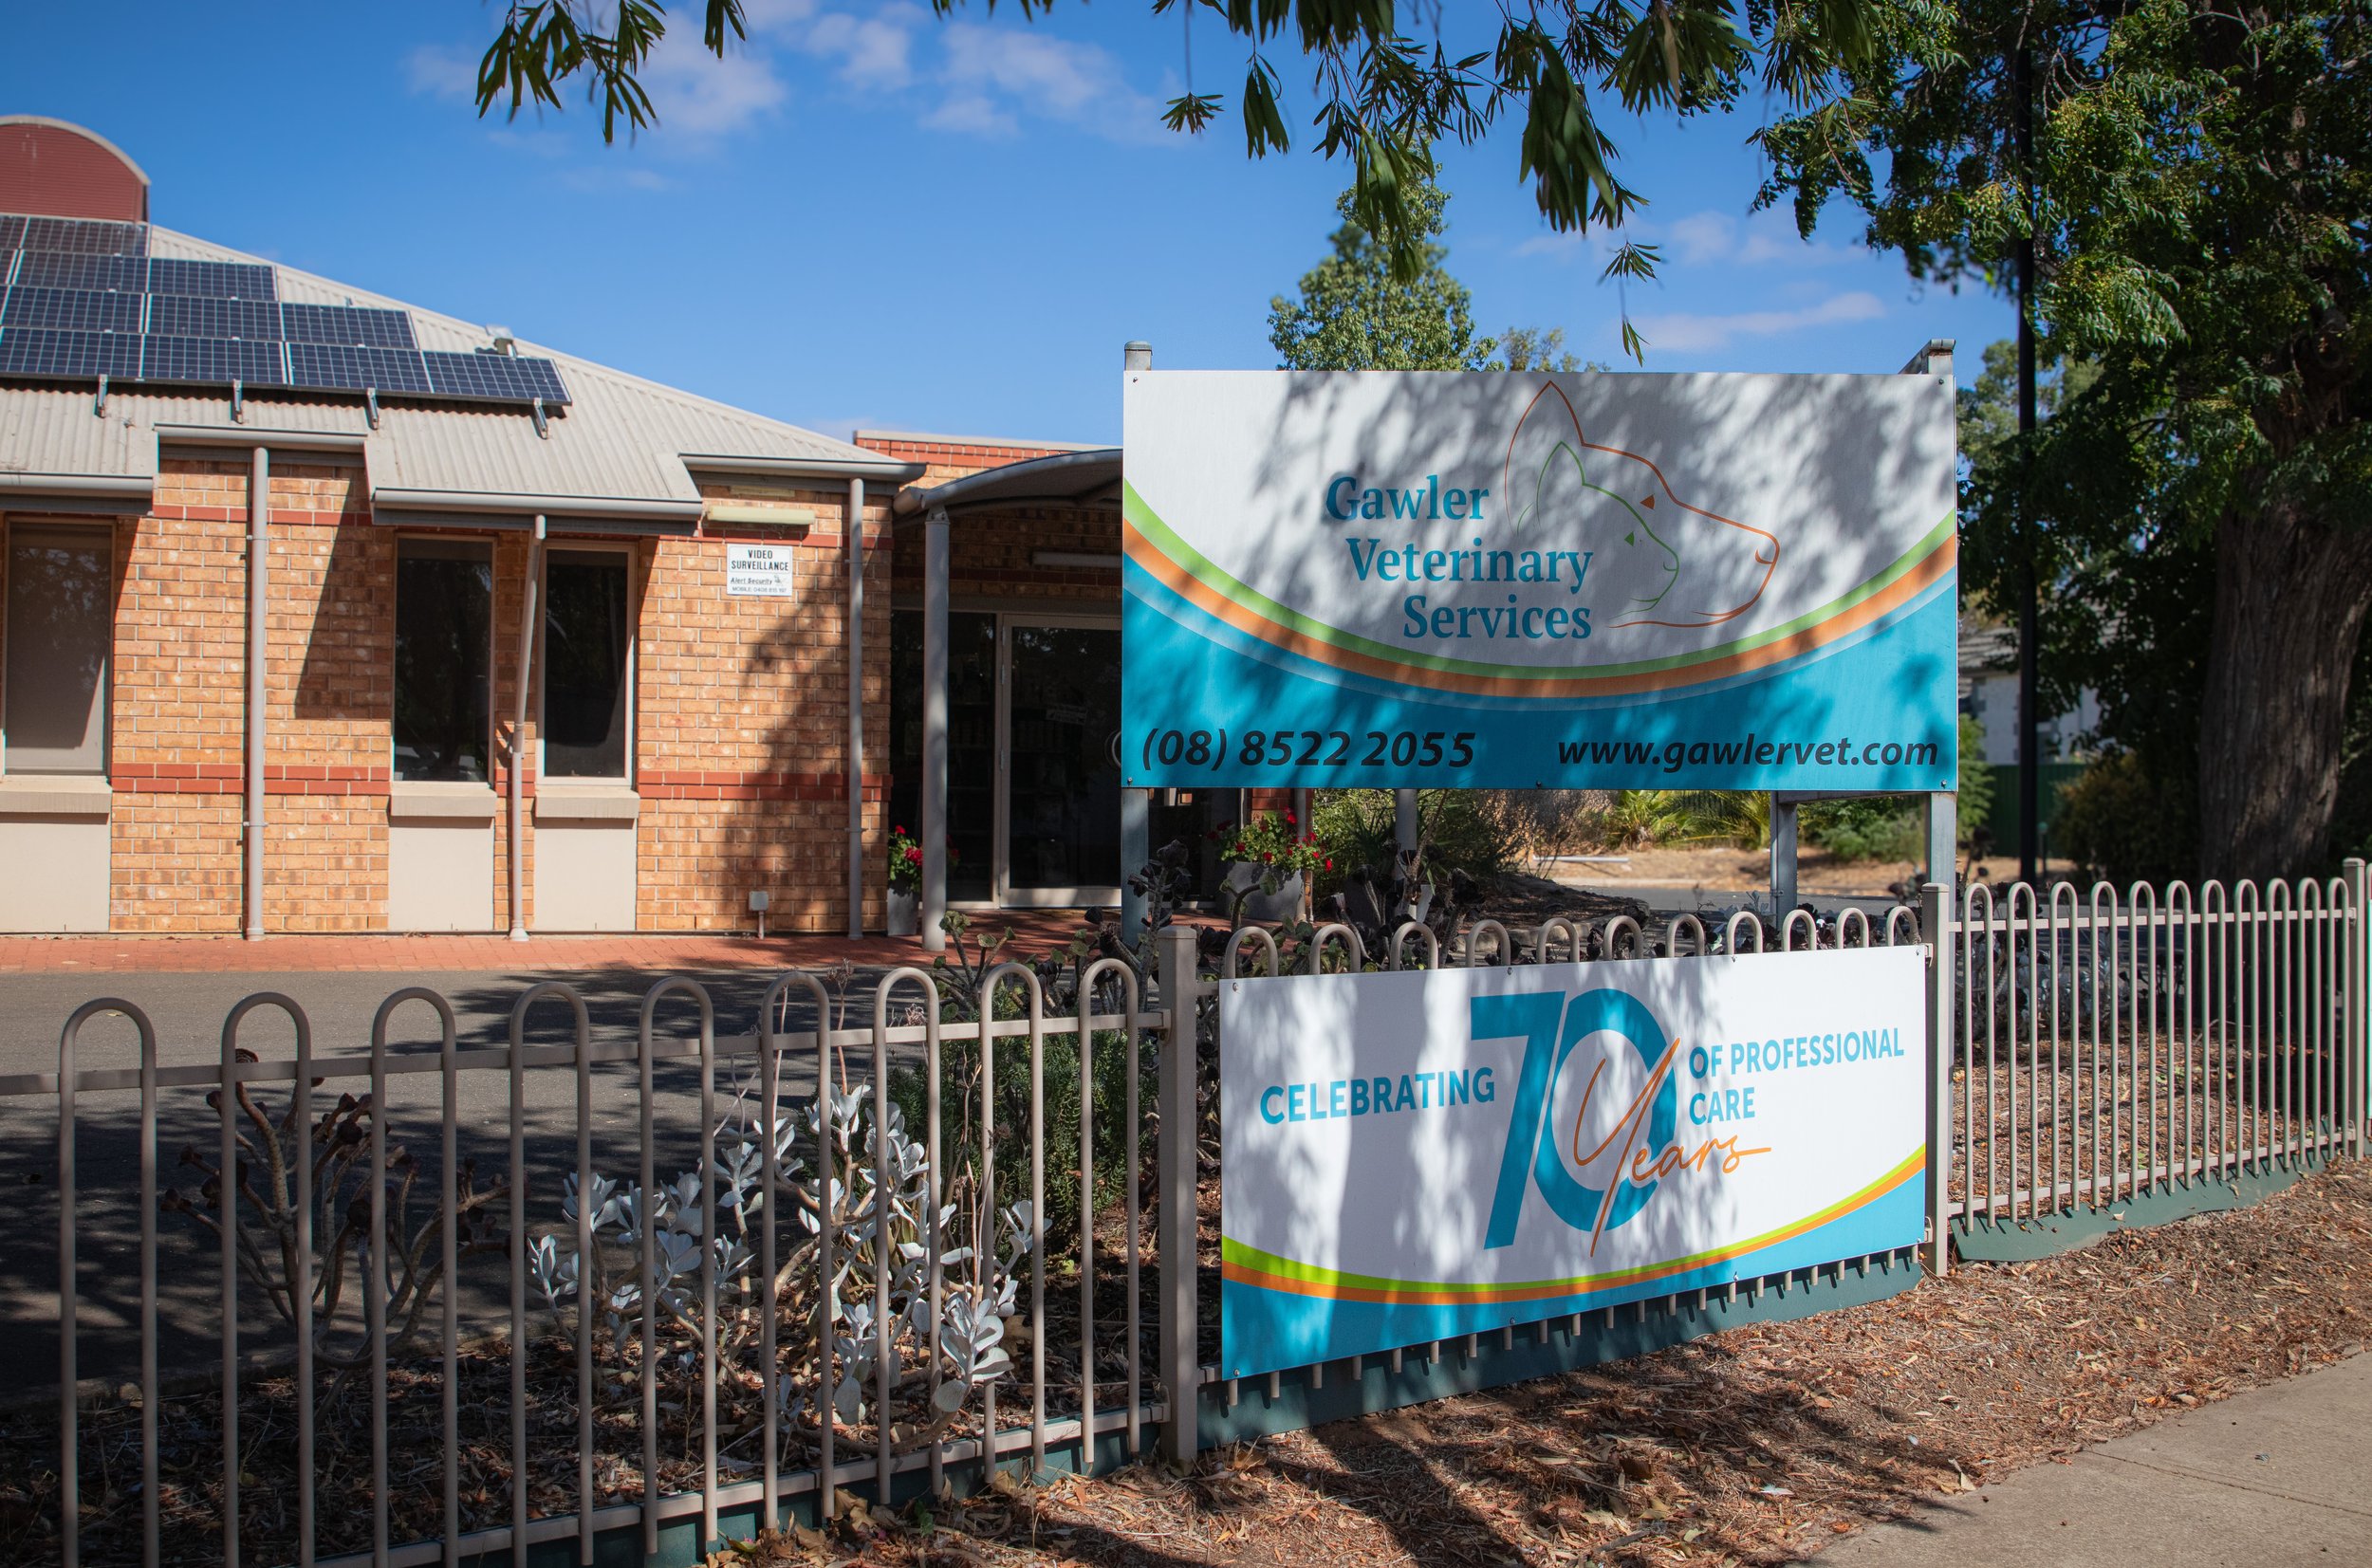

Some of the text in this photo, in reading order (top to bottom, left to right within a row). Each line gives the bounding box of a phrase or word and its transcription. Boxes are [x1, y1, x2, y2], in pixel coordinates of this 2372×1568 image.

[1326, 474, 1490, 521] Gawler
[731, 560, 789, 571] SURVEILLANCE
[748, 549, 773, 560] VIDEO
[1345, 537, 1594, 595] Veterinary
[748, 577, 772, 585] Security
[1403, 594, 1592, 639] Services
[1142, 728, 1476, 771] (08) 8522 2055
[1557, 732, 1938, 773] www.gawlervet.com
[1689, 1027, 1905, 1079] OF PROFESSIONAL
[1260, 1067, 1495, 1124] CELEBRATING
[1689, 1086, 1755, 1125] CARE
[1471, 988, 1677, 1250] 70
[1573, 1038, 1772, 1258] Years
